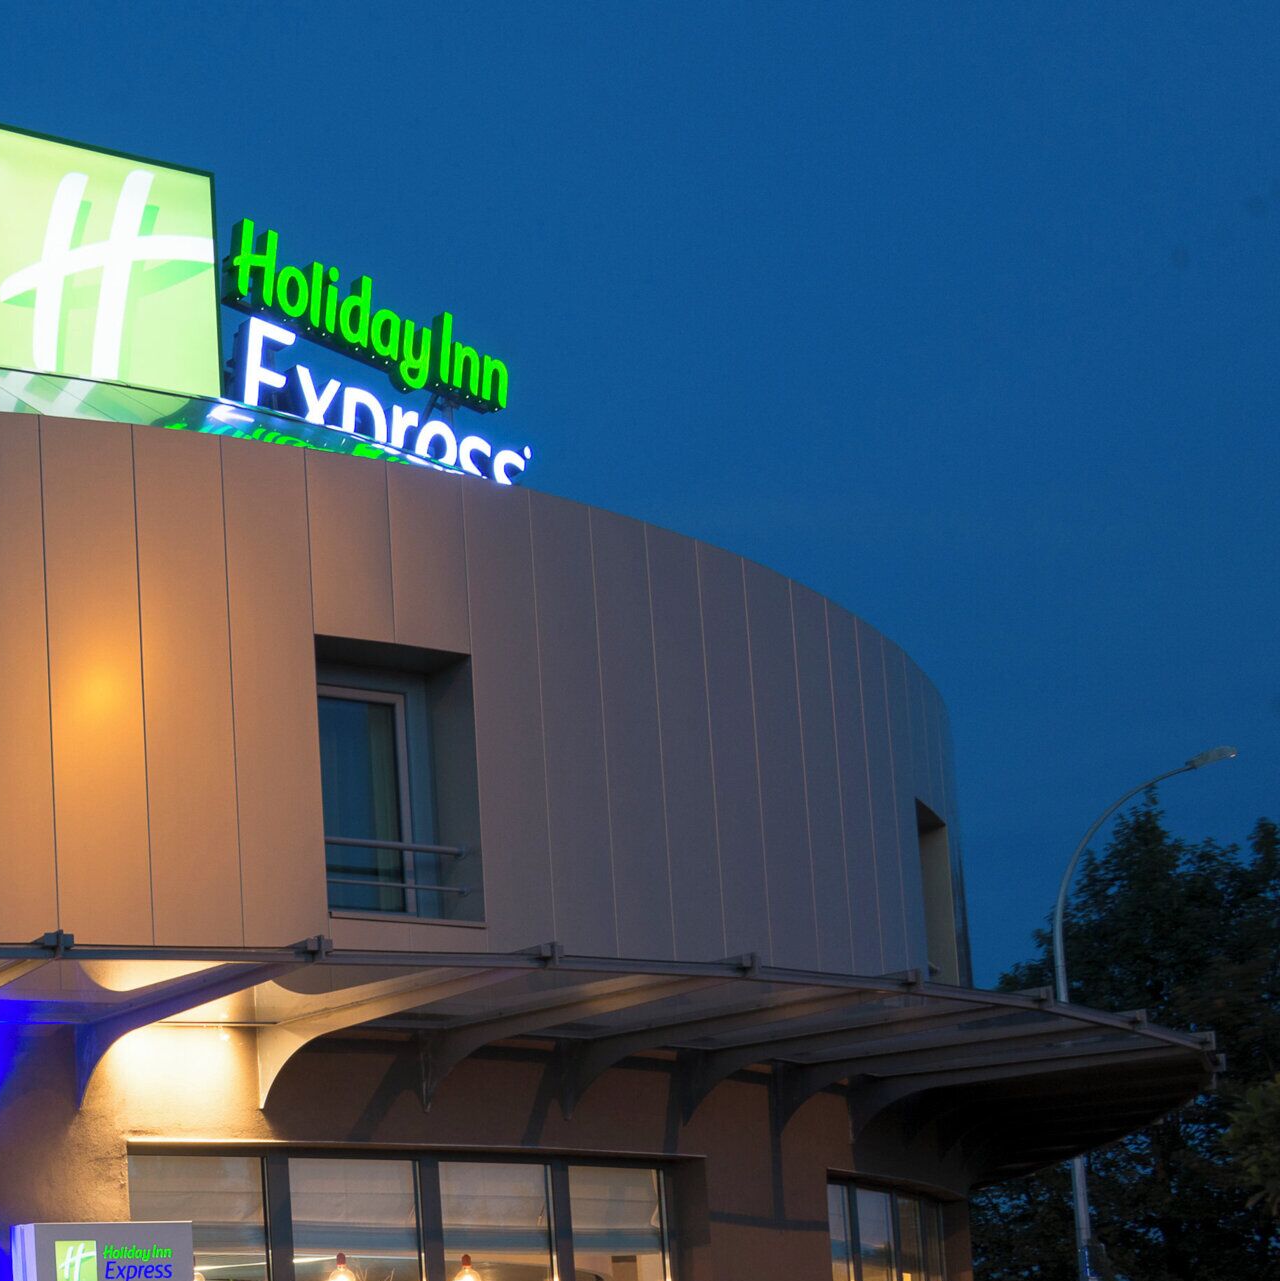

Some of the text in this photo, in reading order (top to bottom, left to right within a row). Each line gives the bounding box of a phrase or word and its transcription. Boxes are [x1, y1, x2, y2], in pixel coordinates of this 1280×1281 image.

[233, 217, 509, 409] Holiday Inn
[103, 1244, 173, 1261] Holiday Inn
